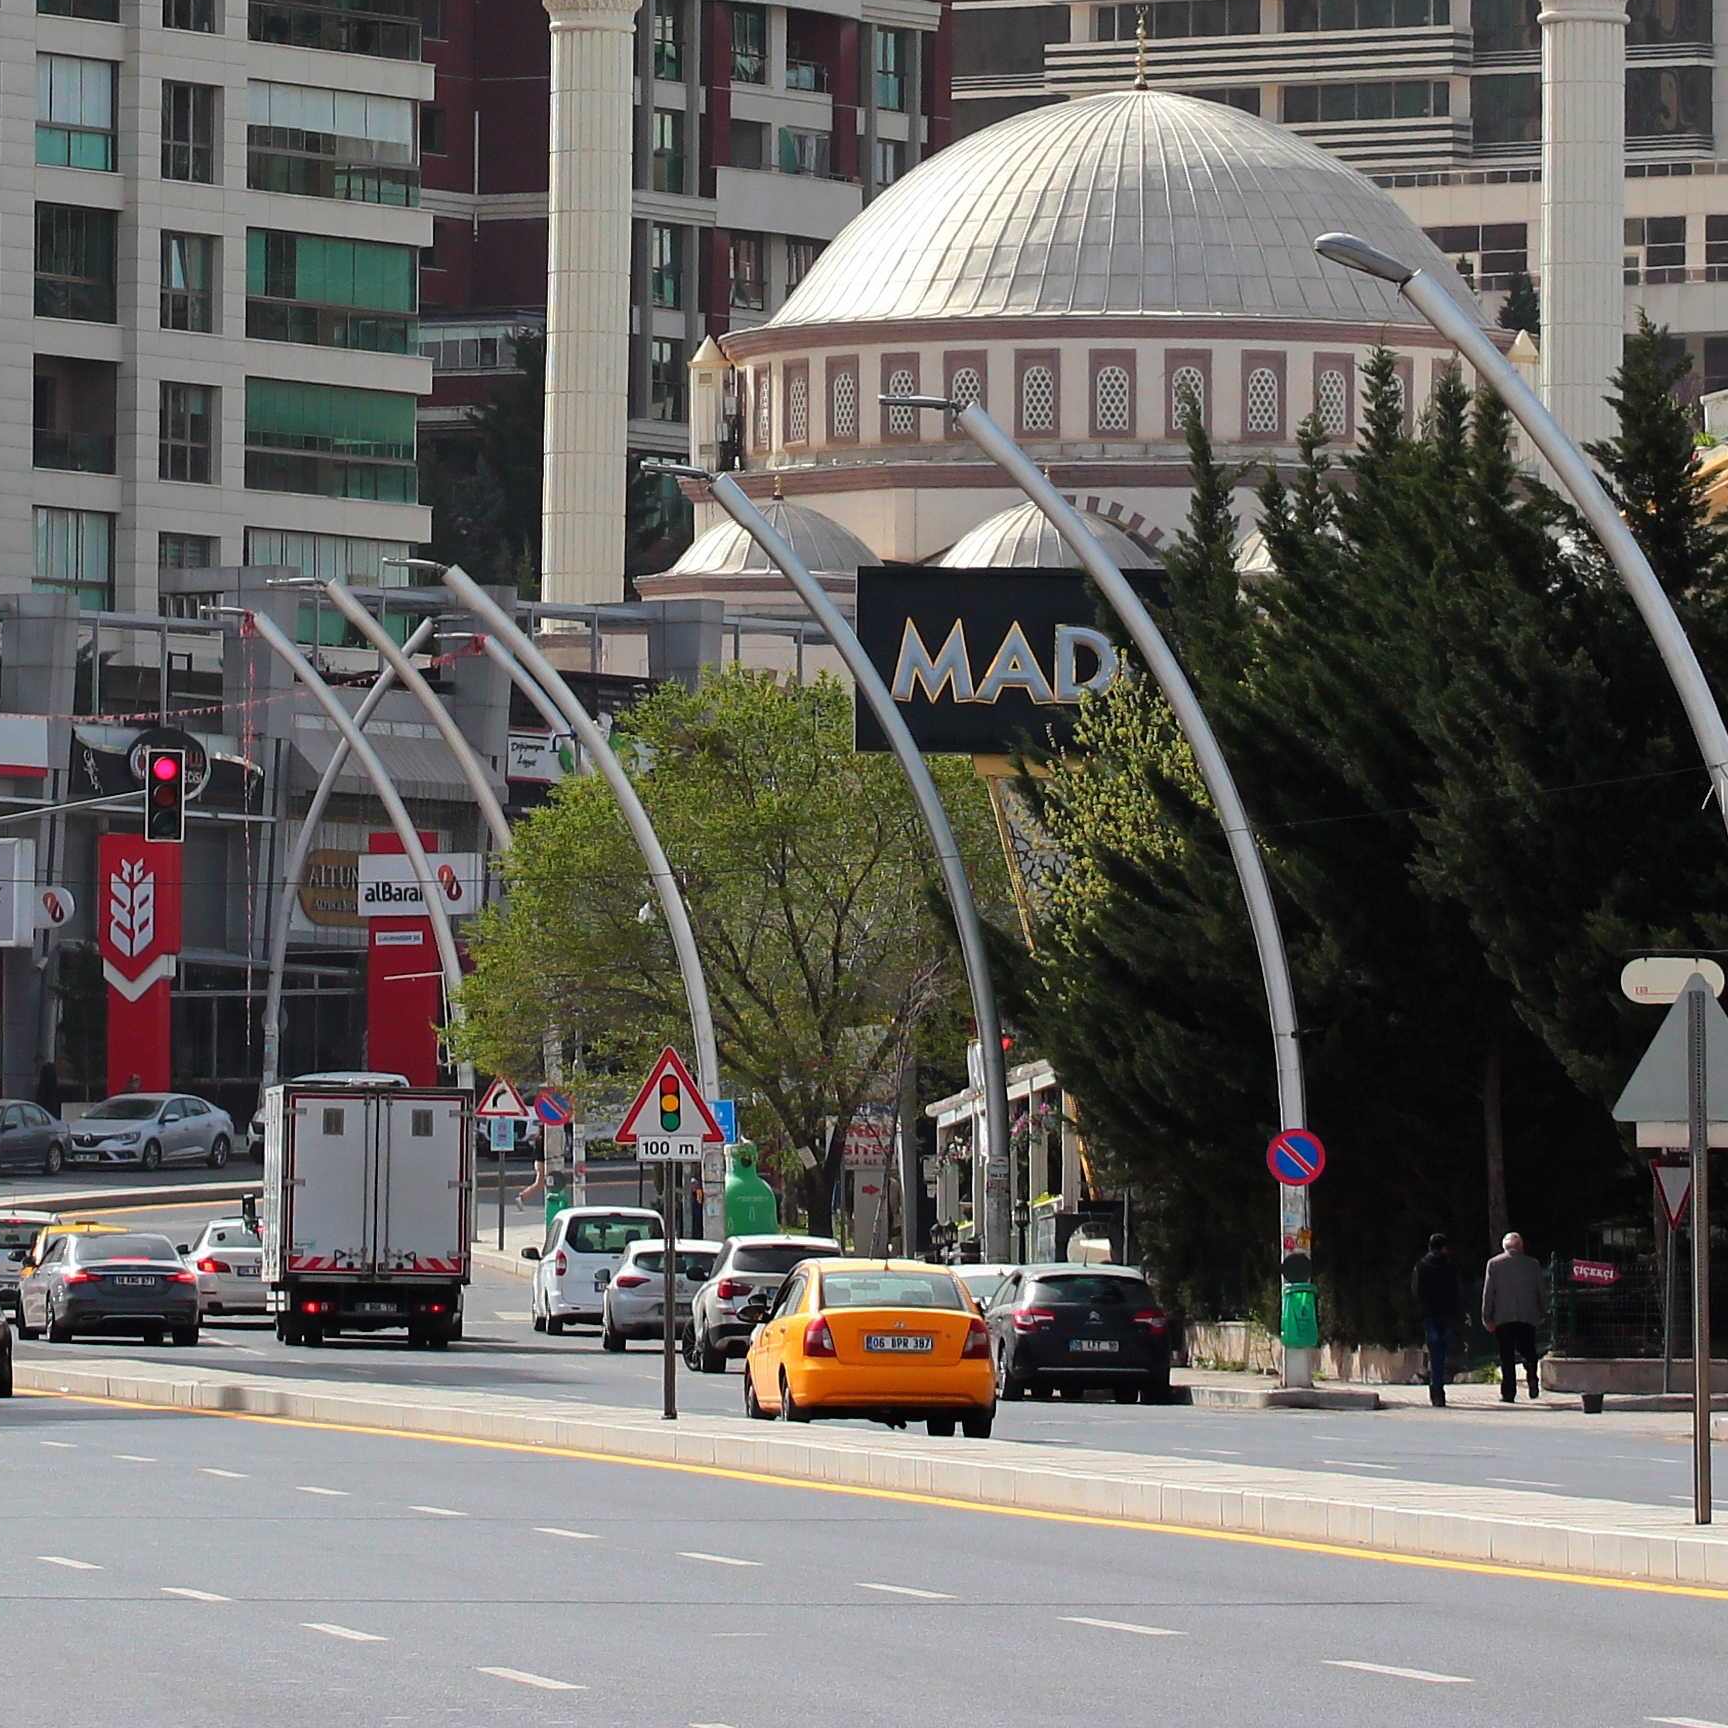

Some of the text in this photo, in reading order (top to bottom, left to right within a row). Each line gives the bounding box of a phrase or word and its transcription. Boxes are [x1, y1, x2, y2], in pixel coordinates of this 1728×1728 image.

[890, 616, 1134, 706] MAD
[364, 882, 424, 902] alBara
[642, 1141, 698, 1155] 100 m.
[873, 1338, 885, 1348] 06
[891, 1337, 909, 1349] BPR
